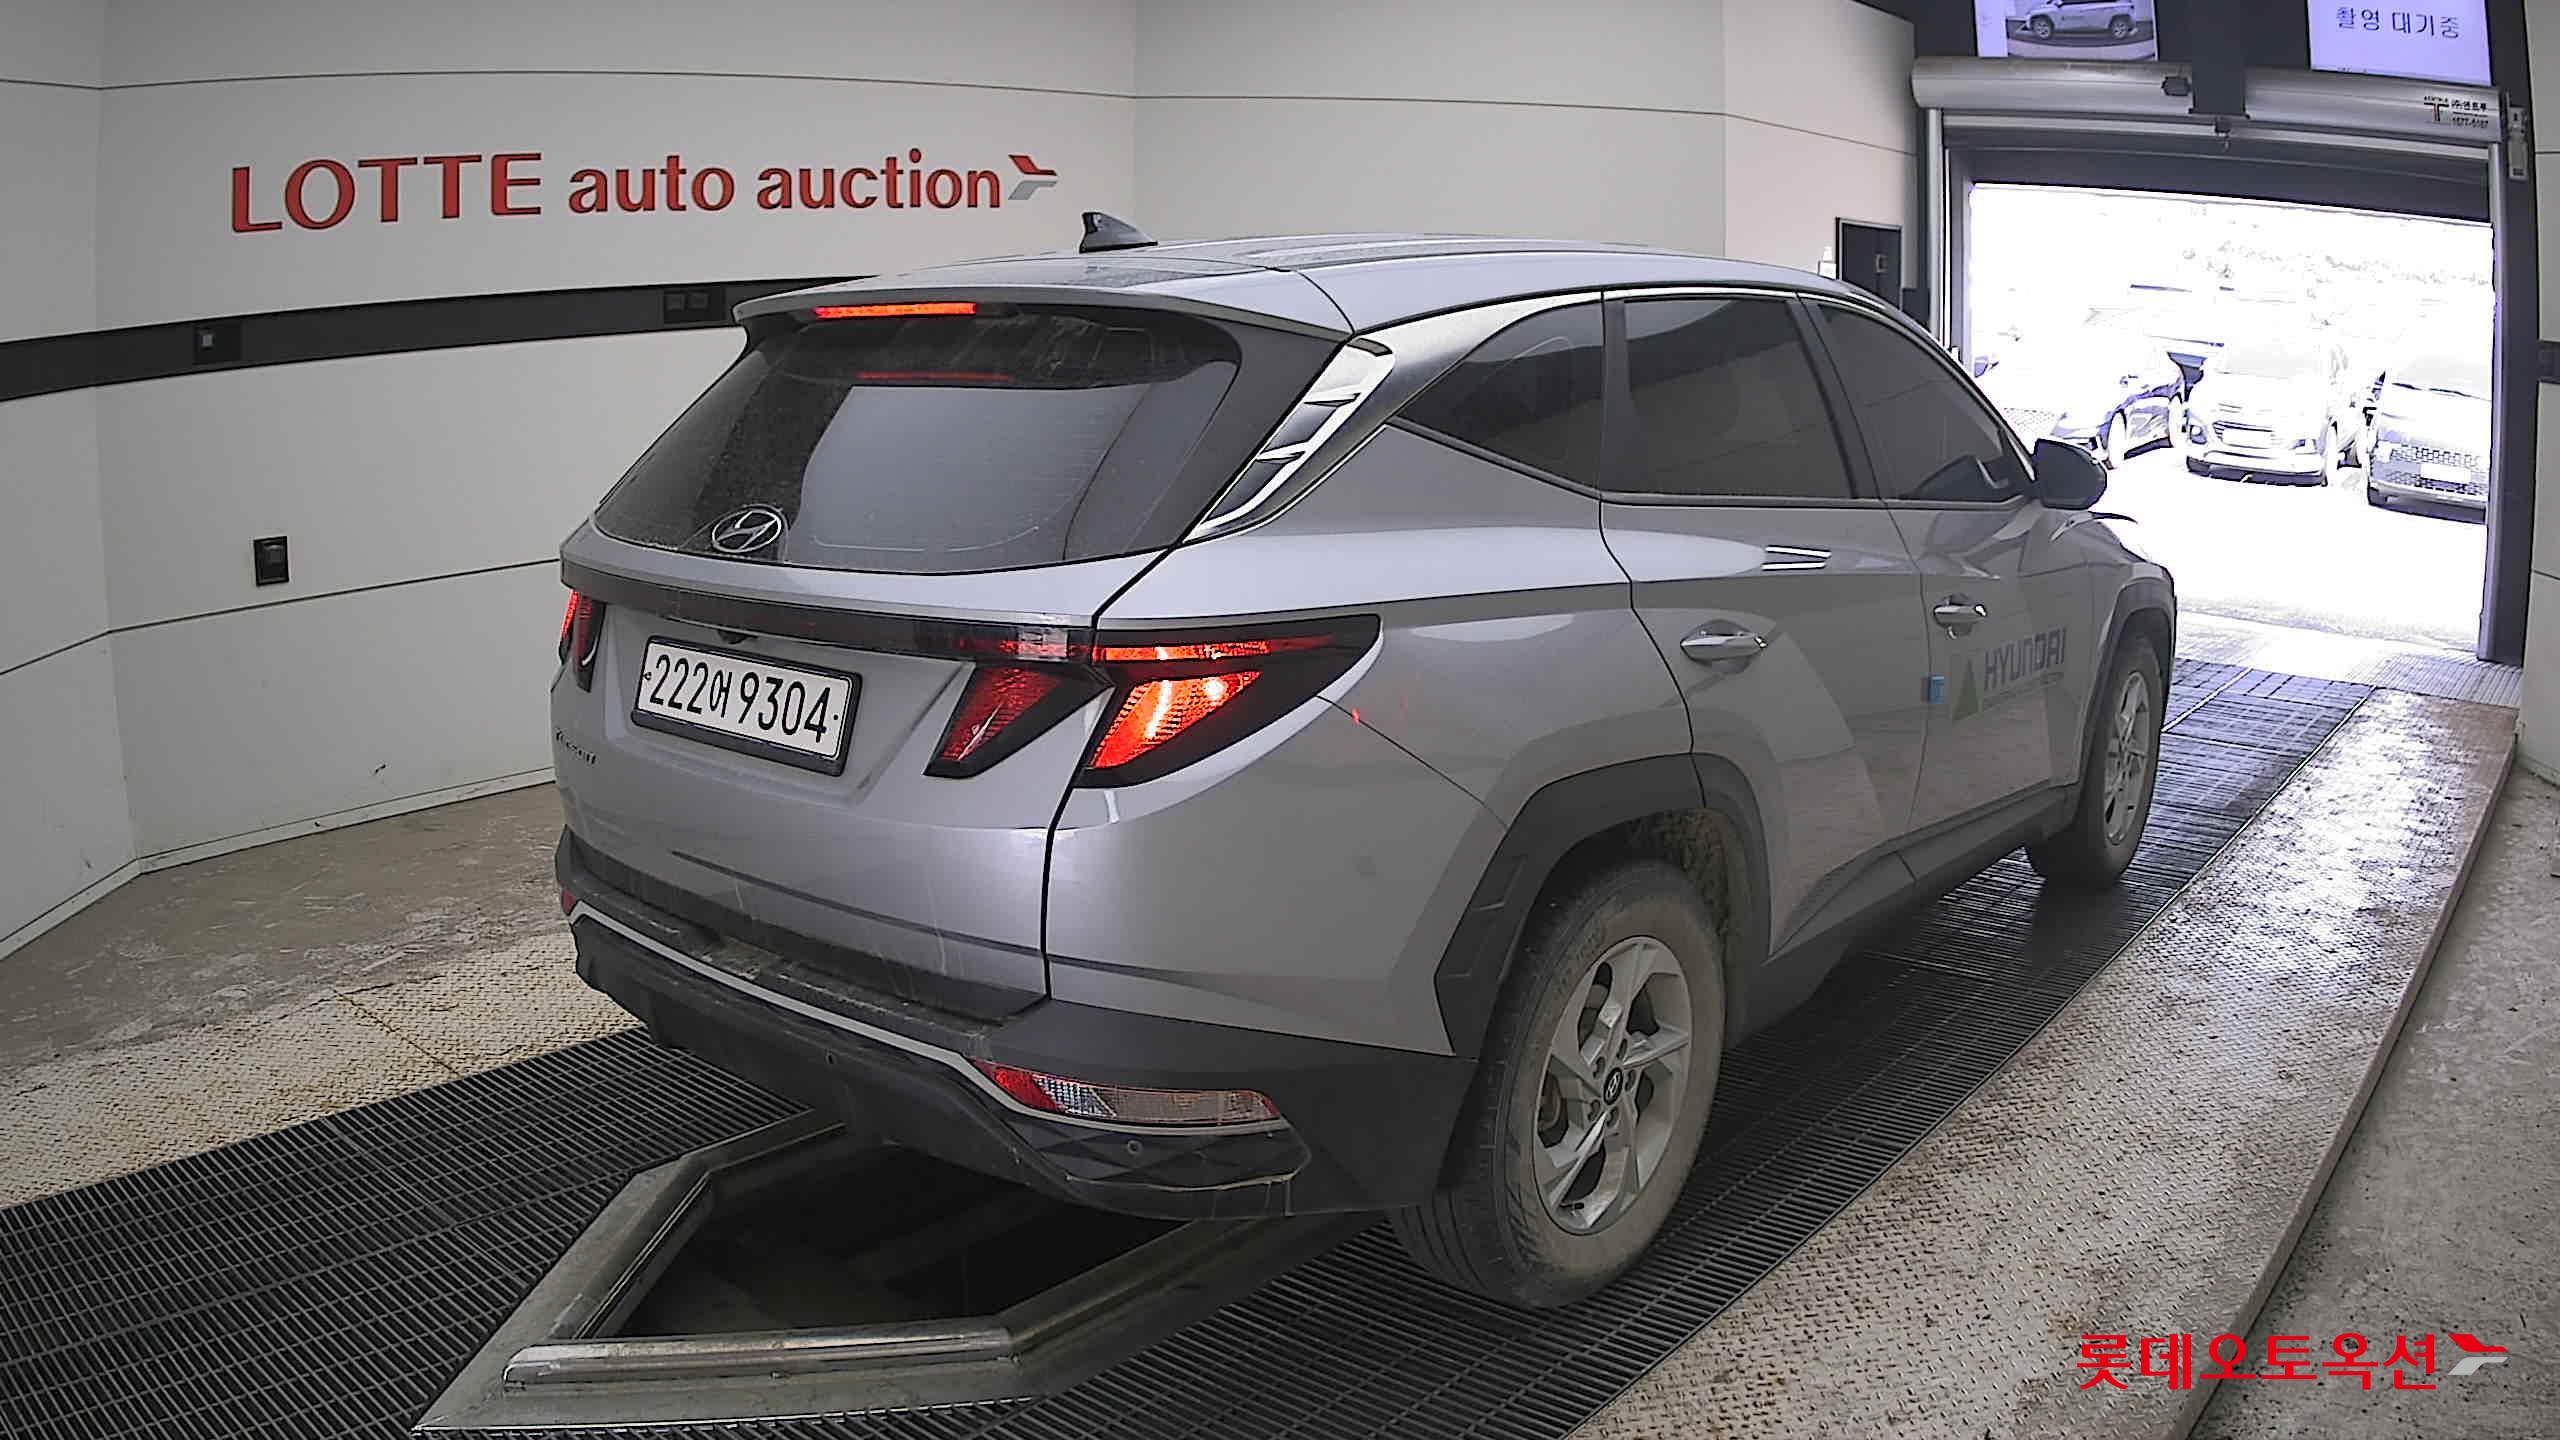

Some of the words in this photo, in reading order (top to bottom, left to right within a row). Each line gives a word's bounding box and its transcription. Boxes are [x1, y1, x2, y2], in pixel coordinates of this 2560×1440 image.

[2337, 7, 2379, 31] 촬영
[2392, 12, 2459, 39] 대기중
[231, 152, 542, 233] LOTTE
[567, 155, 735, 213] auto
[757, 148, 1001, 210] auction
[1984, 626, 2067, 691] HYUNDAI
